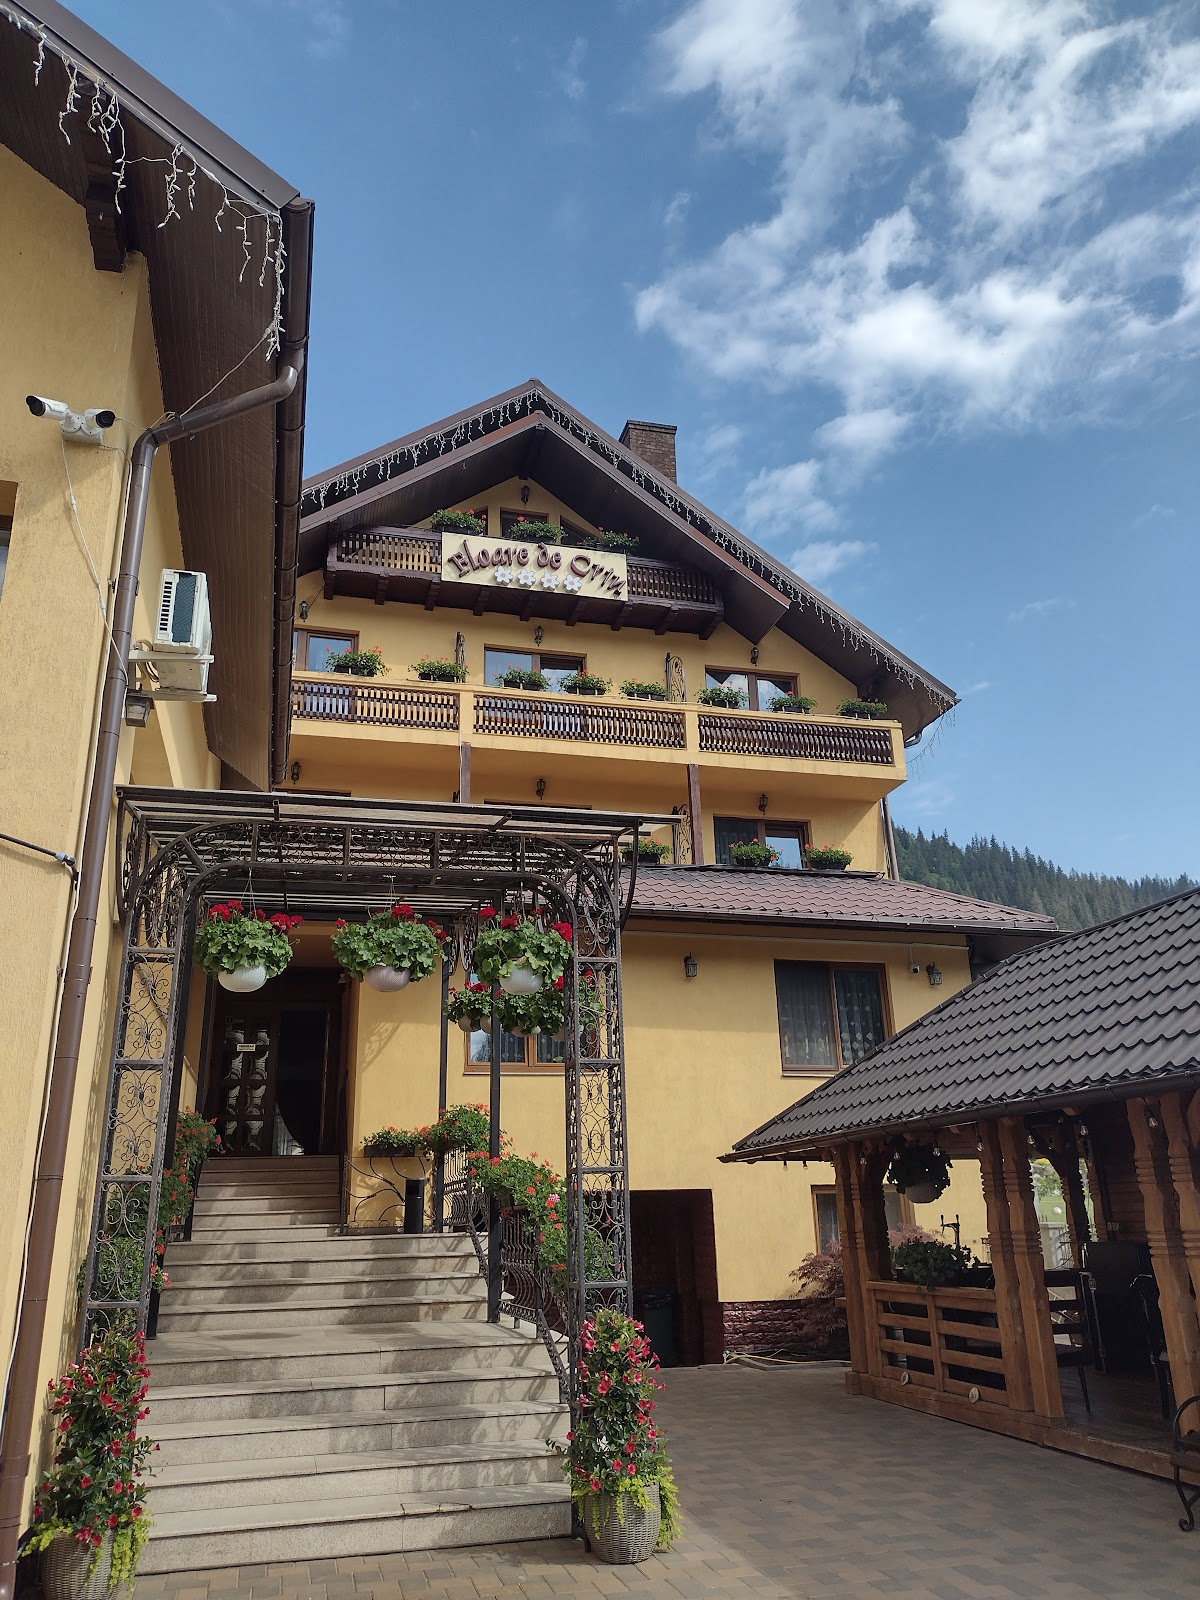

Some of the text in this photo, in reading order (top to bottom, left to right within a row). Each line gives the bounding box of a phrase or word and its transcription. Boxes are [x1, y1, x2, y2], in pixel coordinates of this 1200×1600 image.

[448, 538, 626, 596] Floare de Crin
